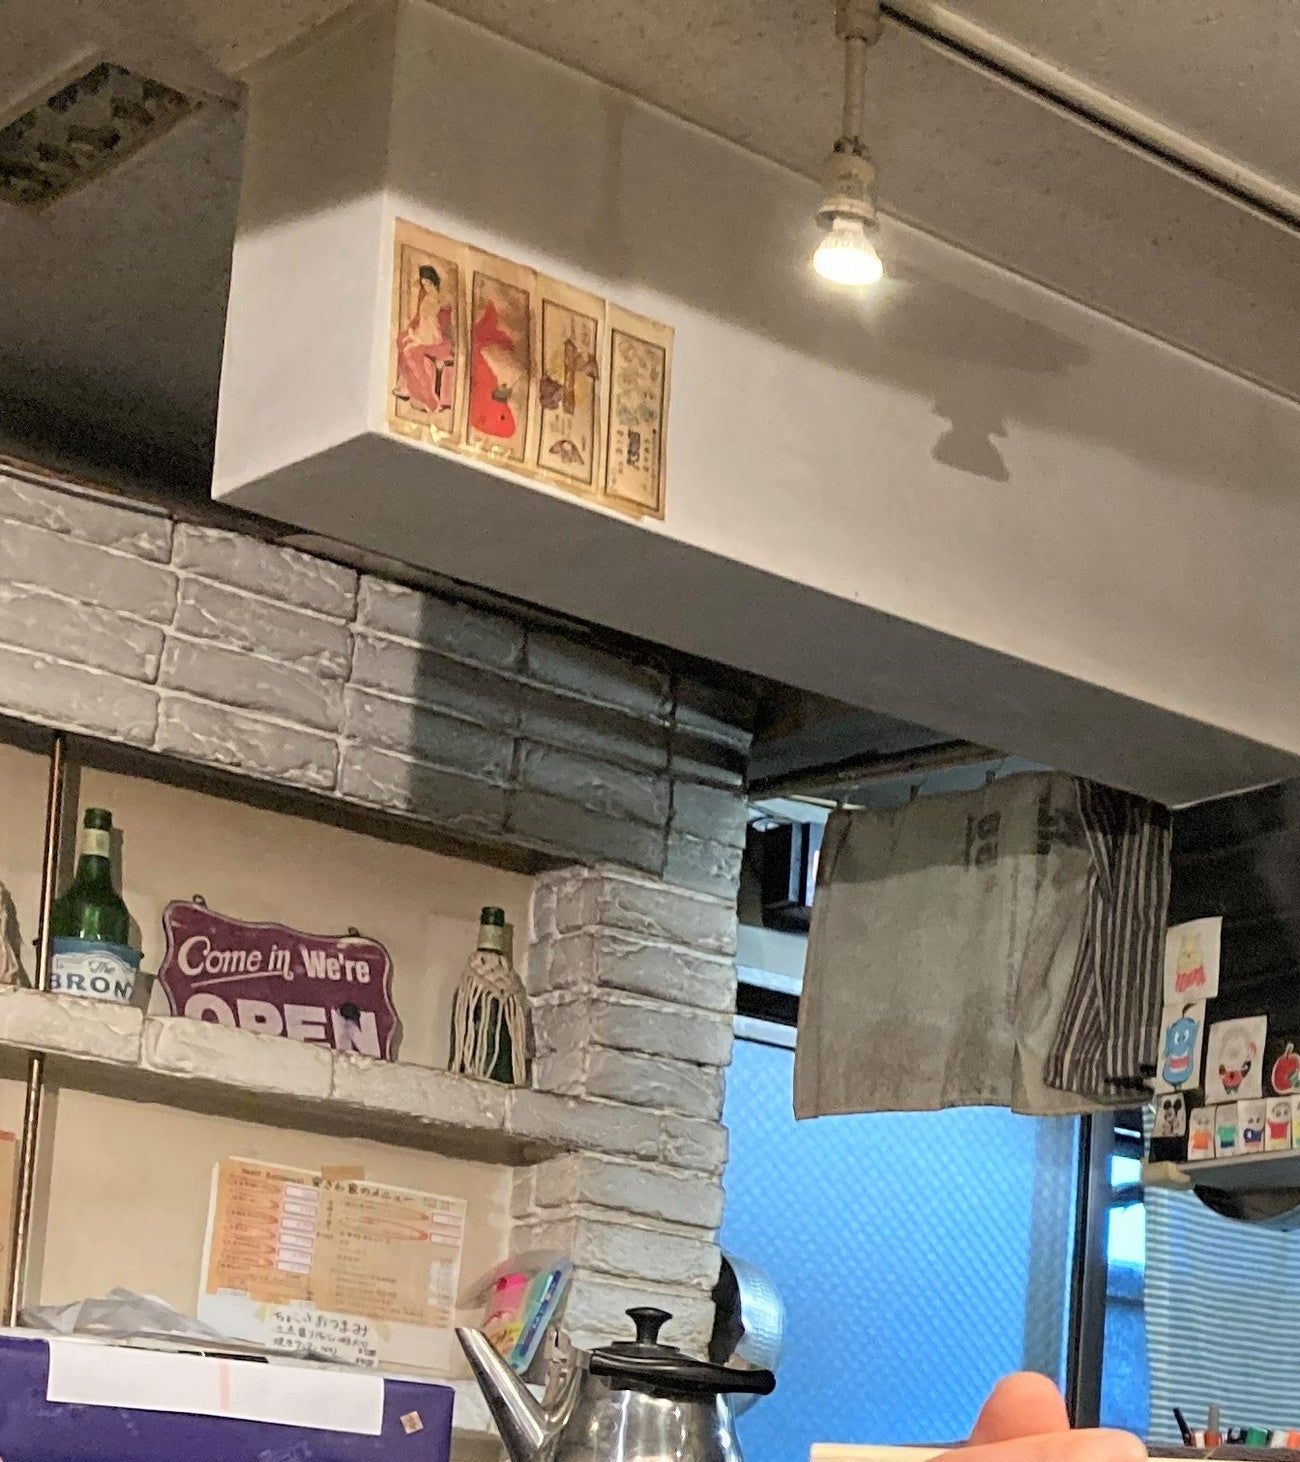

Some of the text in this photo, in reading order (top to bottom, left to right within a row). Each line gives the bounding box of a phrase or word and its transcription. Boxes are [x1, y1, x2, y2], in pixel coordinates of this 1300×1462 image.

[178, 936, 370, 984] Come in We're
[184, 993, 381, 1058] OPEN
